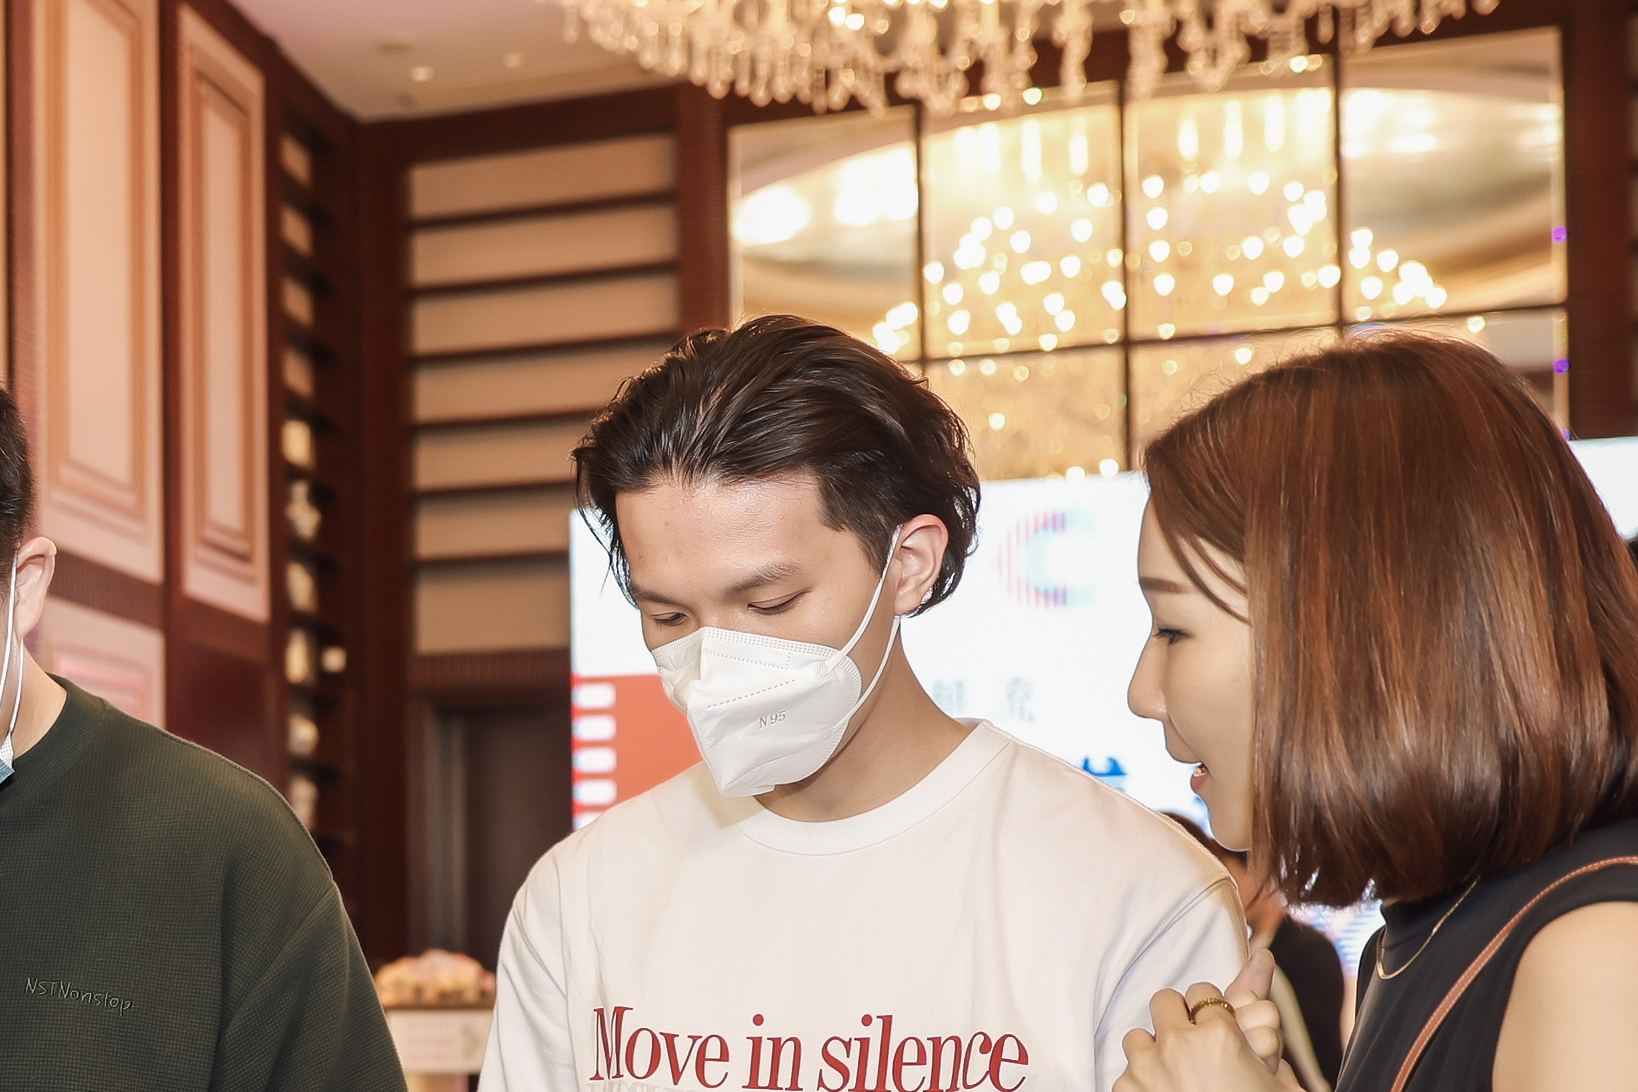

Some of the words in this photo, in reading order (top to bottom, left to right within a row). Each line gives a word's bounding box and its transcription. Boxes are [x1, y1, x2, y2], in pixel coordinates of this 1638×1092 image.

[758, 709, 787, 729] N95
[589, 1005, 730, 1086] Move
[741, 1013, 804, 1092] in
